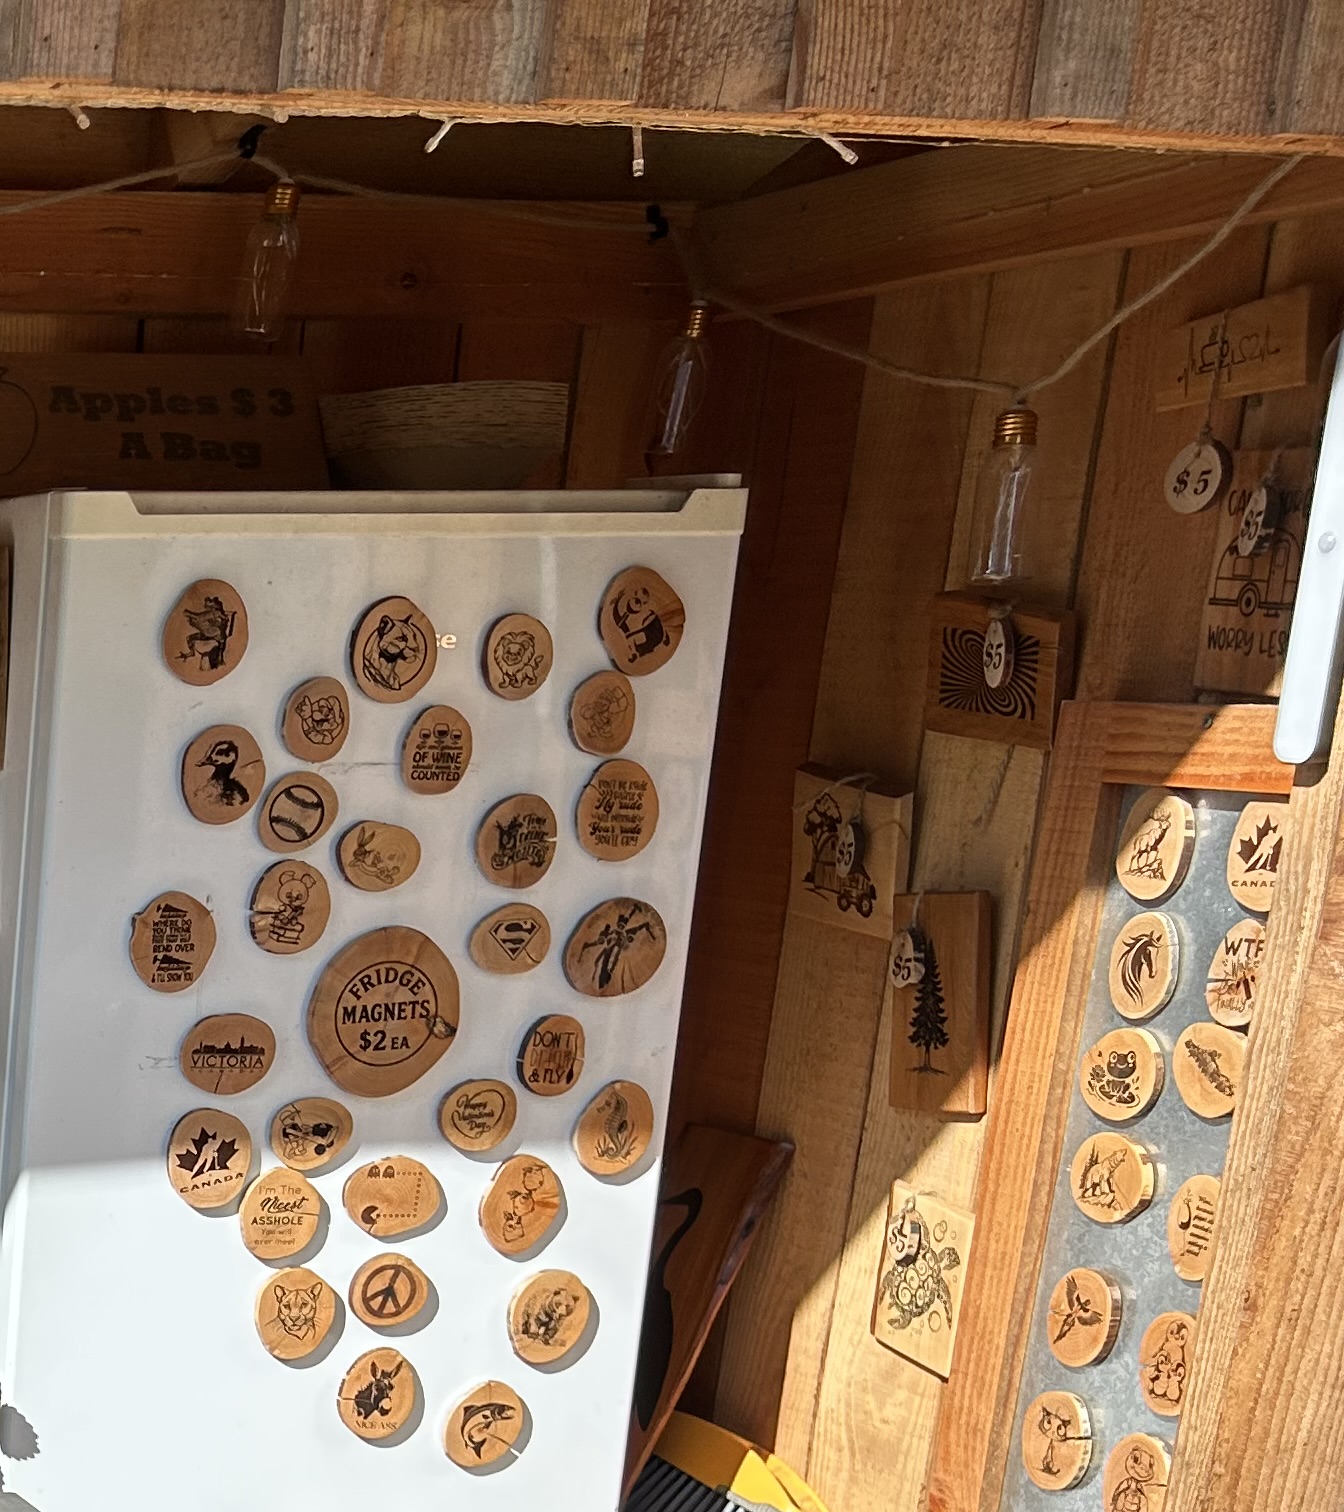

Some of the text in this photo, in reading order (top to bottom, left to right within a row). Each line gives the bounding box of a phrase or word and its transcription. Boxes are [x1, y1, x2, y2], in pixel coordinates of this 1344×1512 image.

[48, 385, 220, 422] Apples
[118, 431, 262, 469] A Bag
[1172, 468, 1210, 498] $5
[1241, 509, 1263, 540] $5
[1207, 625, 1289, 658] WORRY LES
[985, 642, 1004, 671] $5
[412, 751, 463, 765] OF WINE
[410, 769, 461, 781] COUNTED
[837, 840, 853, 865] $5
[892, 956, 915, 982] $5
[348, 967, 427, 1001] FRIDGE
[341, 1000, 431, 1025] MAGNETS
[359, 1028, 411, 1052] $2 EA
[191, 1054, 264, 1068] VICTORIA
[179, 1172, 245, 1194] CANADA
[280, 1185, 302, 1196] The
[260, 1196, 310, 1214] Nicest
[250, 1215, 304, 1226] ASSHOLE
